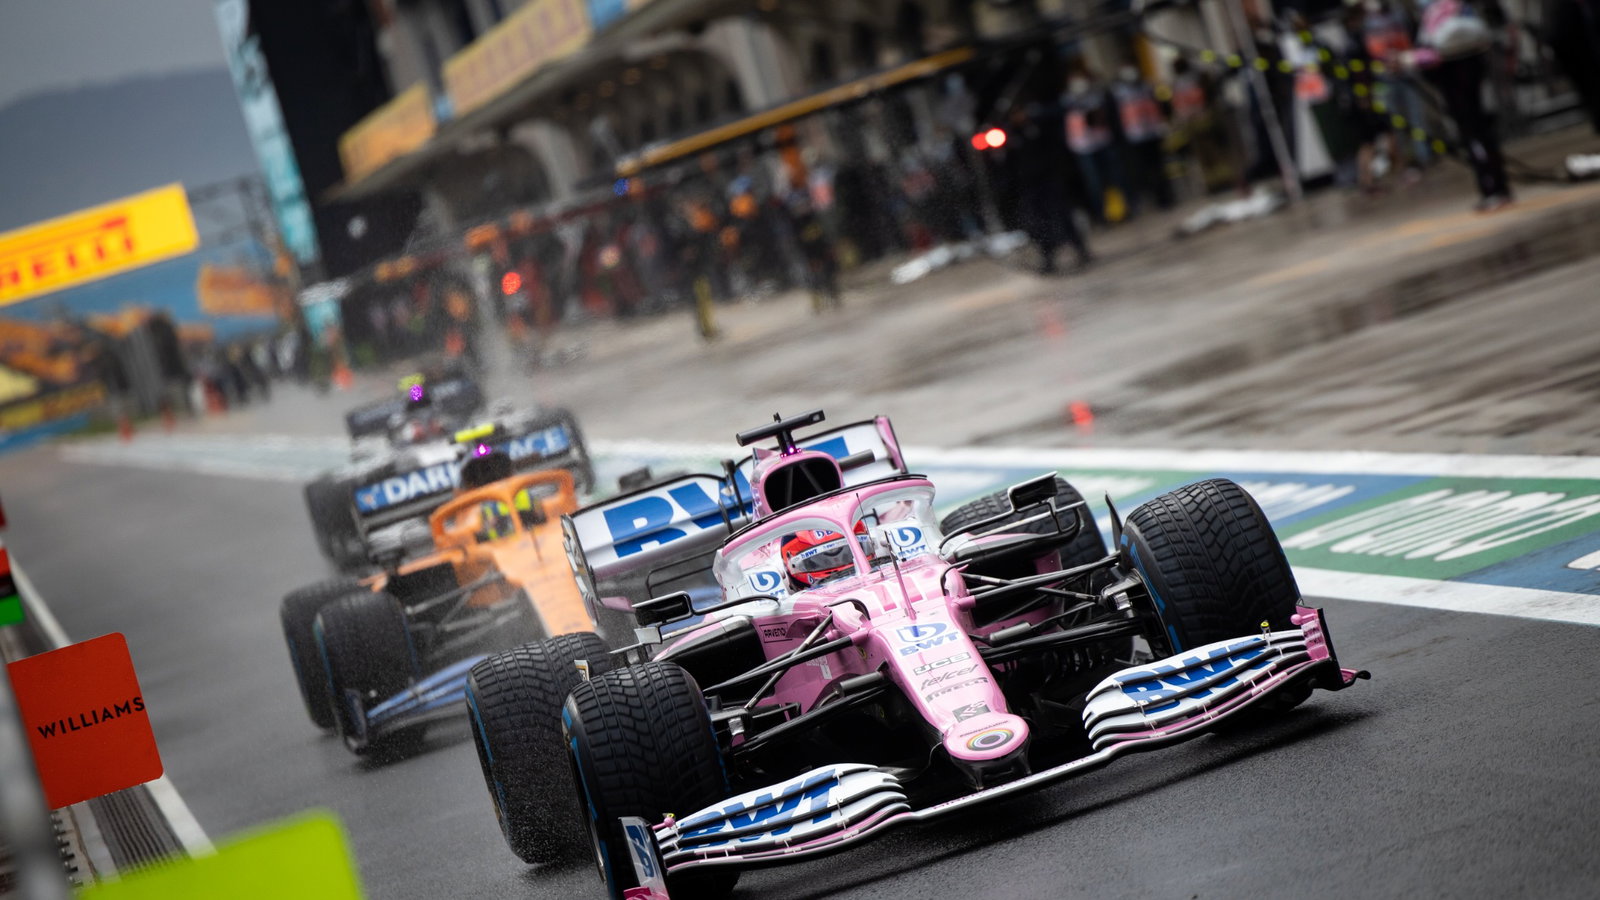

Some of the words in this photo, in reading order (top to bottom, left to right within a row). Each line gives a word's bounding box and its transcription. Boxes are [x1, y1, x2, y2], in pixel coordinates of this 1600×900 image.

[900, 631, 959, 657] BWT
[1113, 637, 1277, 716] BWT
[37, 697, 145, 739] WILLIAMS
[676, 768, 840, 852] BWT
